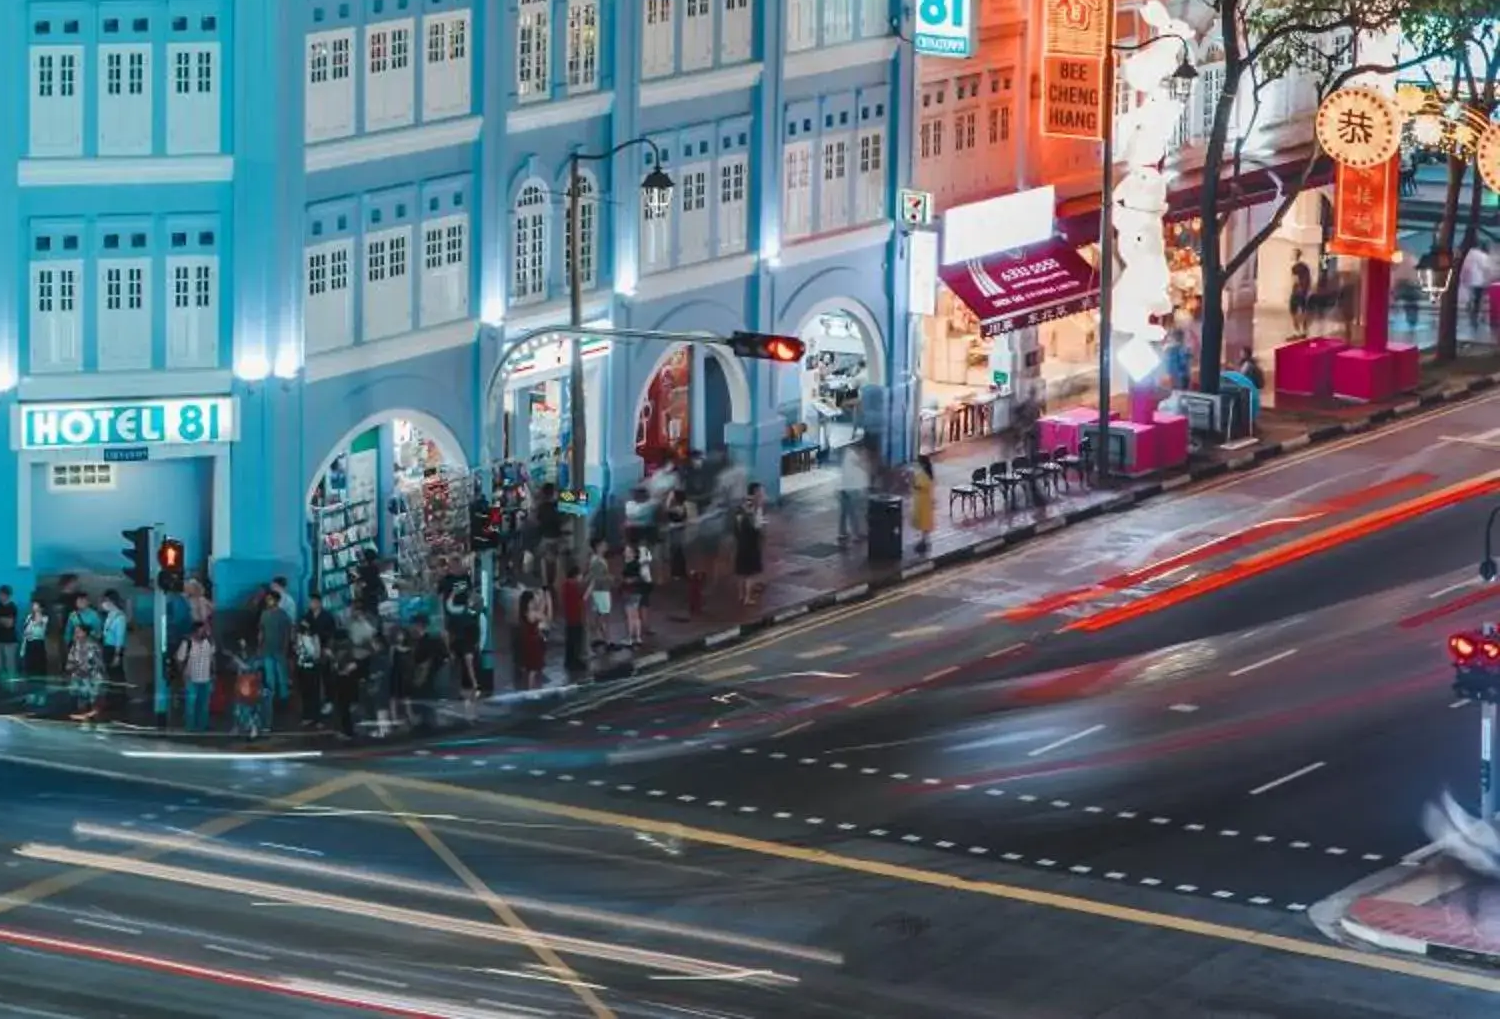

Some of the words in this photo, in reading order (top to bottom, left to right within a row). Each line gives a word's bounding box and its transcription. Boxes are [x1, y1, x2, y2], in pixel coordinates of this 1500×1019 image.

[1060, 61, 1088, 81] BEE
[1049, 84, 1099, 106] CHENG
[1049, 107, 1097, 130] HIANG
[1337, 108, 1374, 144] 恭
[33, 409, 160, 444] HOTEL
[178, 404, 219, 443] 81
